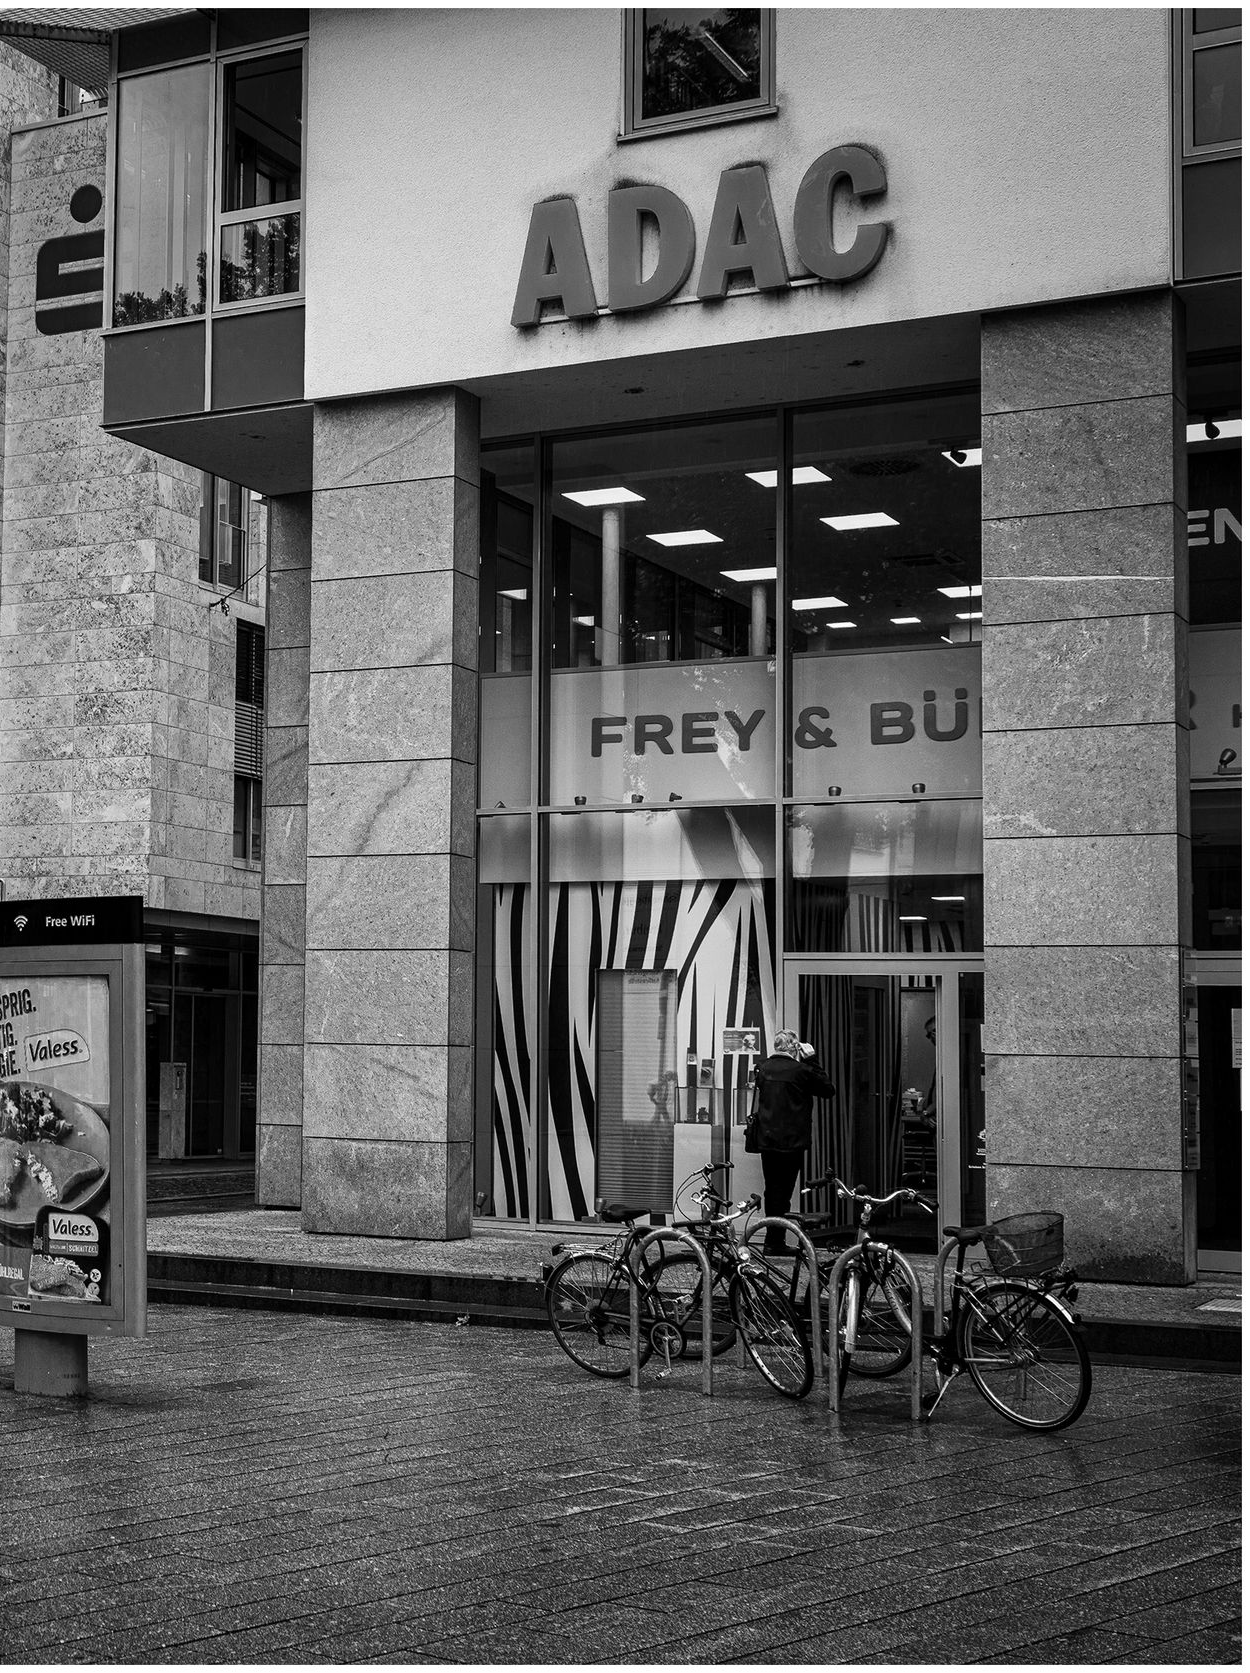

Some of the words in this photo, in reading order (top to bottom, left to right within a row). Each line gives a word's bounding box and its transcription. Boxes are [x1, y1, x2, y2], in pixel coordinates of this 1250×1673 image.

[510, 145, 888, 328] ADAC
[591, 708, 767, 758] FREY
[794, 706, 837, 750] &
[45, 915, 68, 928] Free
[69, 914, 96, 927] WiFi
[28, 1039, 78, 1063] Valess
[52, 1218, 92, 1236] Valess
